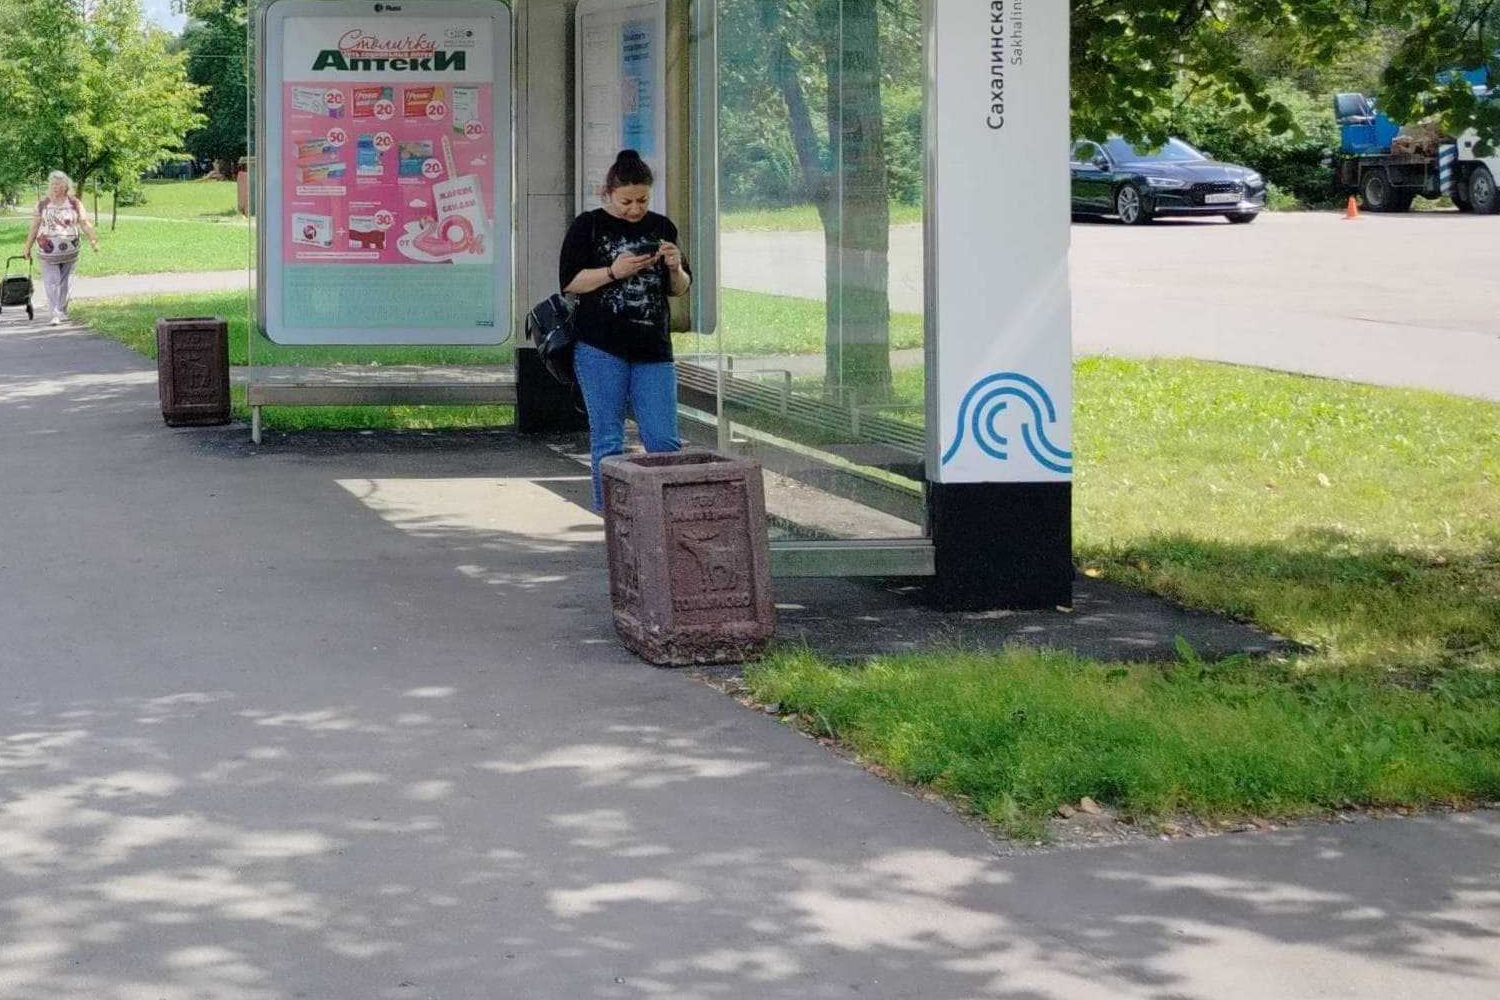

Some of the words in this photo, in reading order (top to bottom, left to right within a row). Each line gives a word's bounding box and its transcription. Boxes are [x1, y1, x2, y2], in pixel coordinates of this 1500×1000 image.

[326, 93, 343, 105] 20
[376, 104, 393, 116] 20
[428, 104, 445, 116] 20
[466, 124, 482, 135] 20
[329, 131, 345, 143] 50
[375, 135, 392, 147] 20
[424, 163, 440, 174] 20
[376, 214, 391, 225] 30
